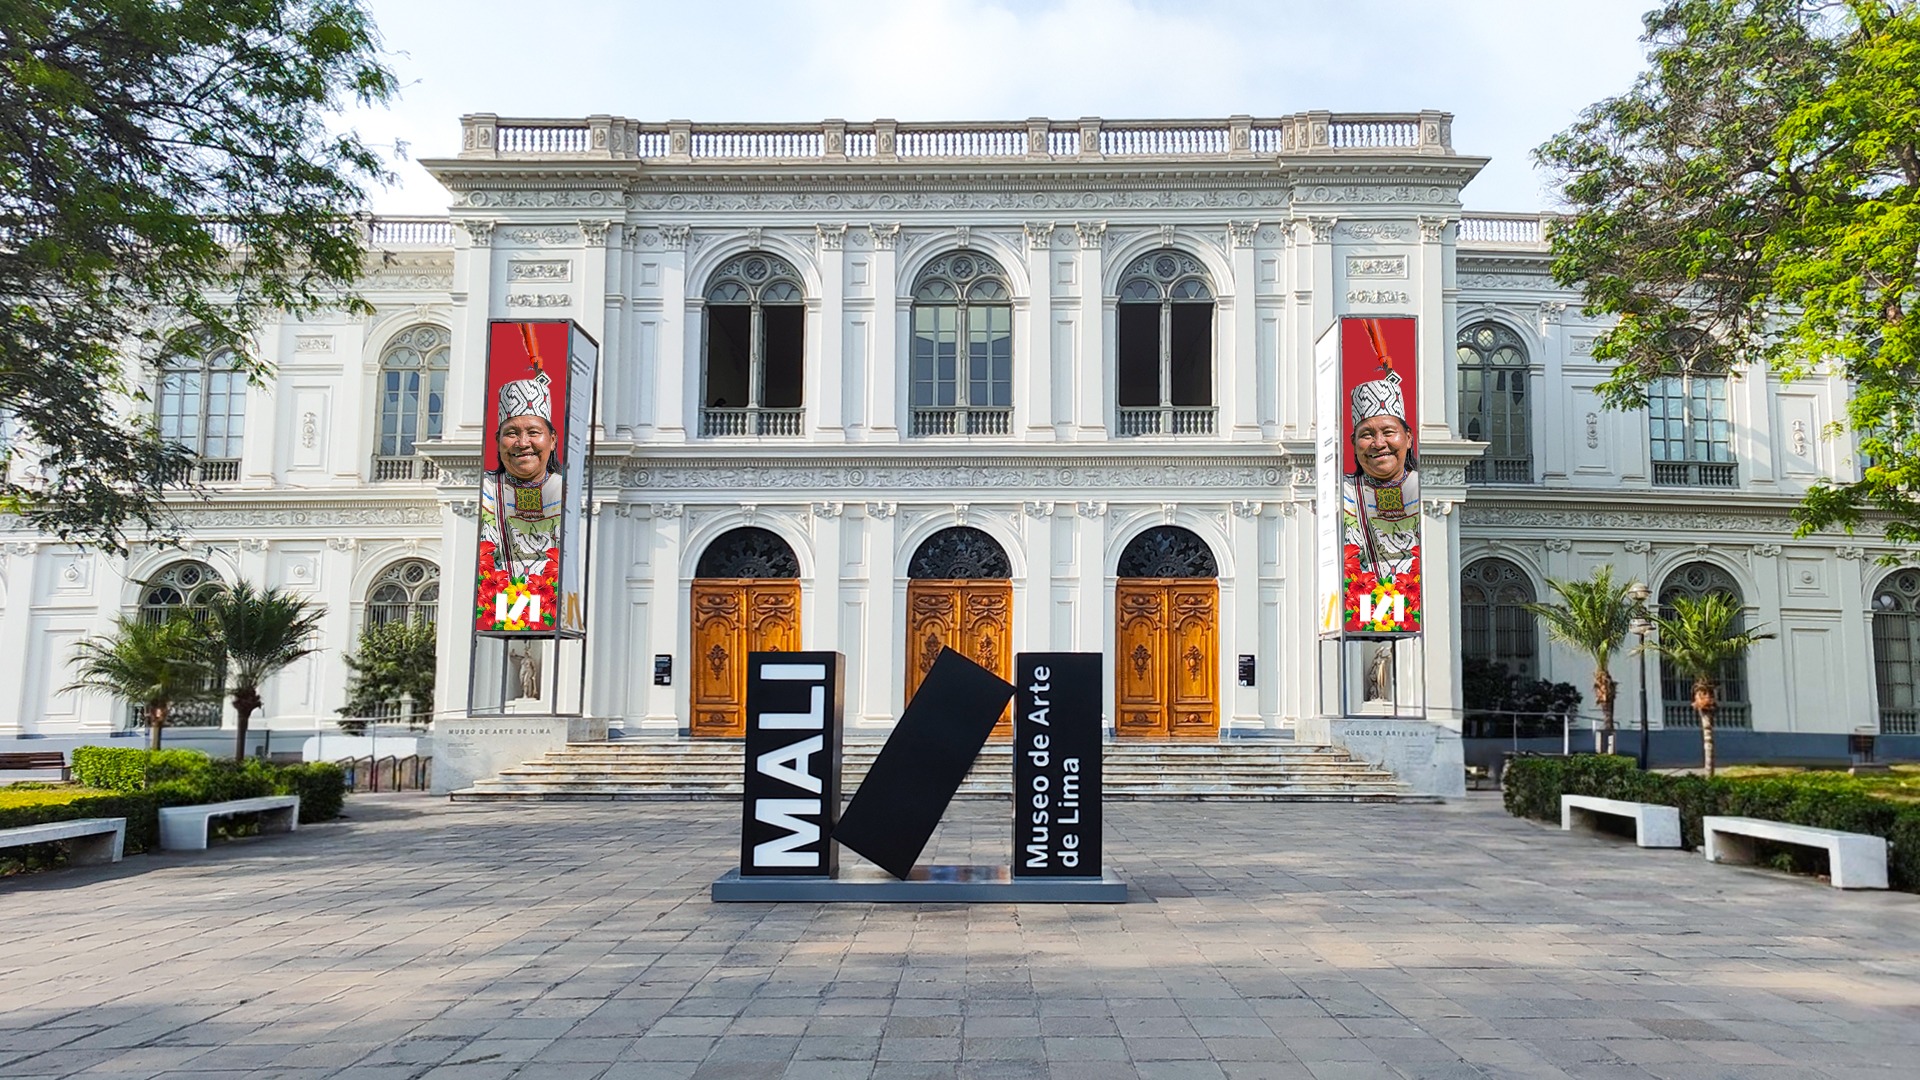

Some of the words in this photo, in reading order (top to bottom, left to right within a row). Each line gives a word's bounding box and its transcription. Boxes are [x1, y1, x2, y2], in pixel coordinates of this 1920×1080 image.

[1027, 665, 1051, 727] Arte
[753, 663, 827, 868] MALI
[1028, 734, 1050, 768] de
[1025, 777, 1050, 868] Museo
[1057, 757, 1080, 824] Lima
[1057, 835, 1079, 868] de
